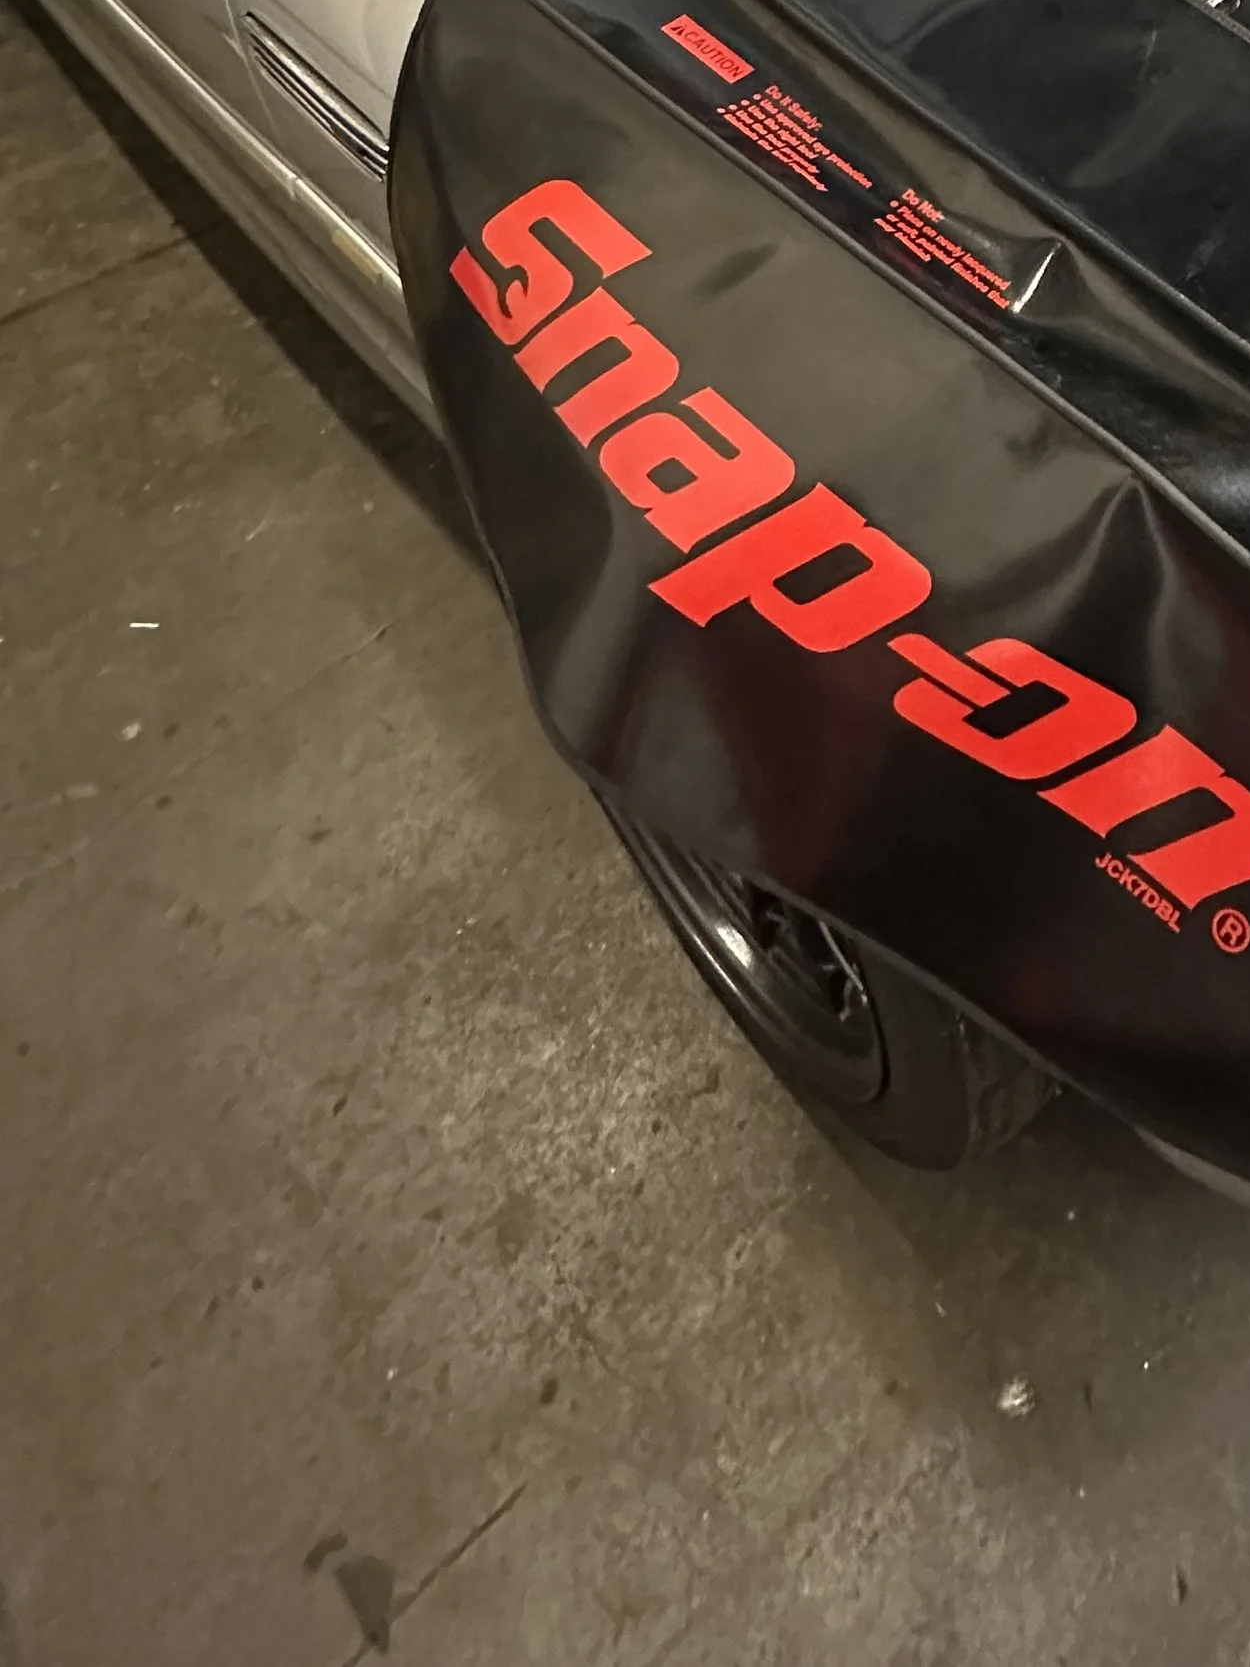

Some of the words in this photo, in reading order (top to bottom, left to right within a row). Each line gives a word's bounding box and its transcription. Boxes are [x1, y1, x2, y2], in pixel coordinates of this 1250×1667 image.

[683, 31, 744, 77] CAUTION
[765, 85, 782, 100] Do
[759, 98, 779, 115] Use
[826, 153, 872, 188] protection
[902, 188, 921, 206] Do
[897, 205, 924, 228] Place
[922, 226, 937, 238] on
[934, 235, 965, 256] newly
[950, 262, 989, 293] finishes
[987, 290, 1010, 308] that
[1096, 854, 1180, 931] JCK7DBL
